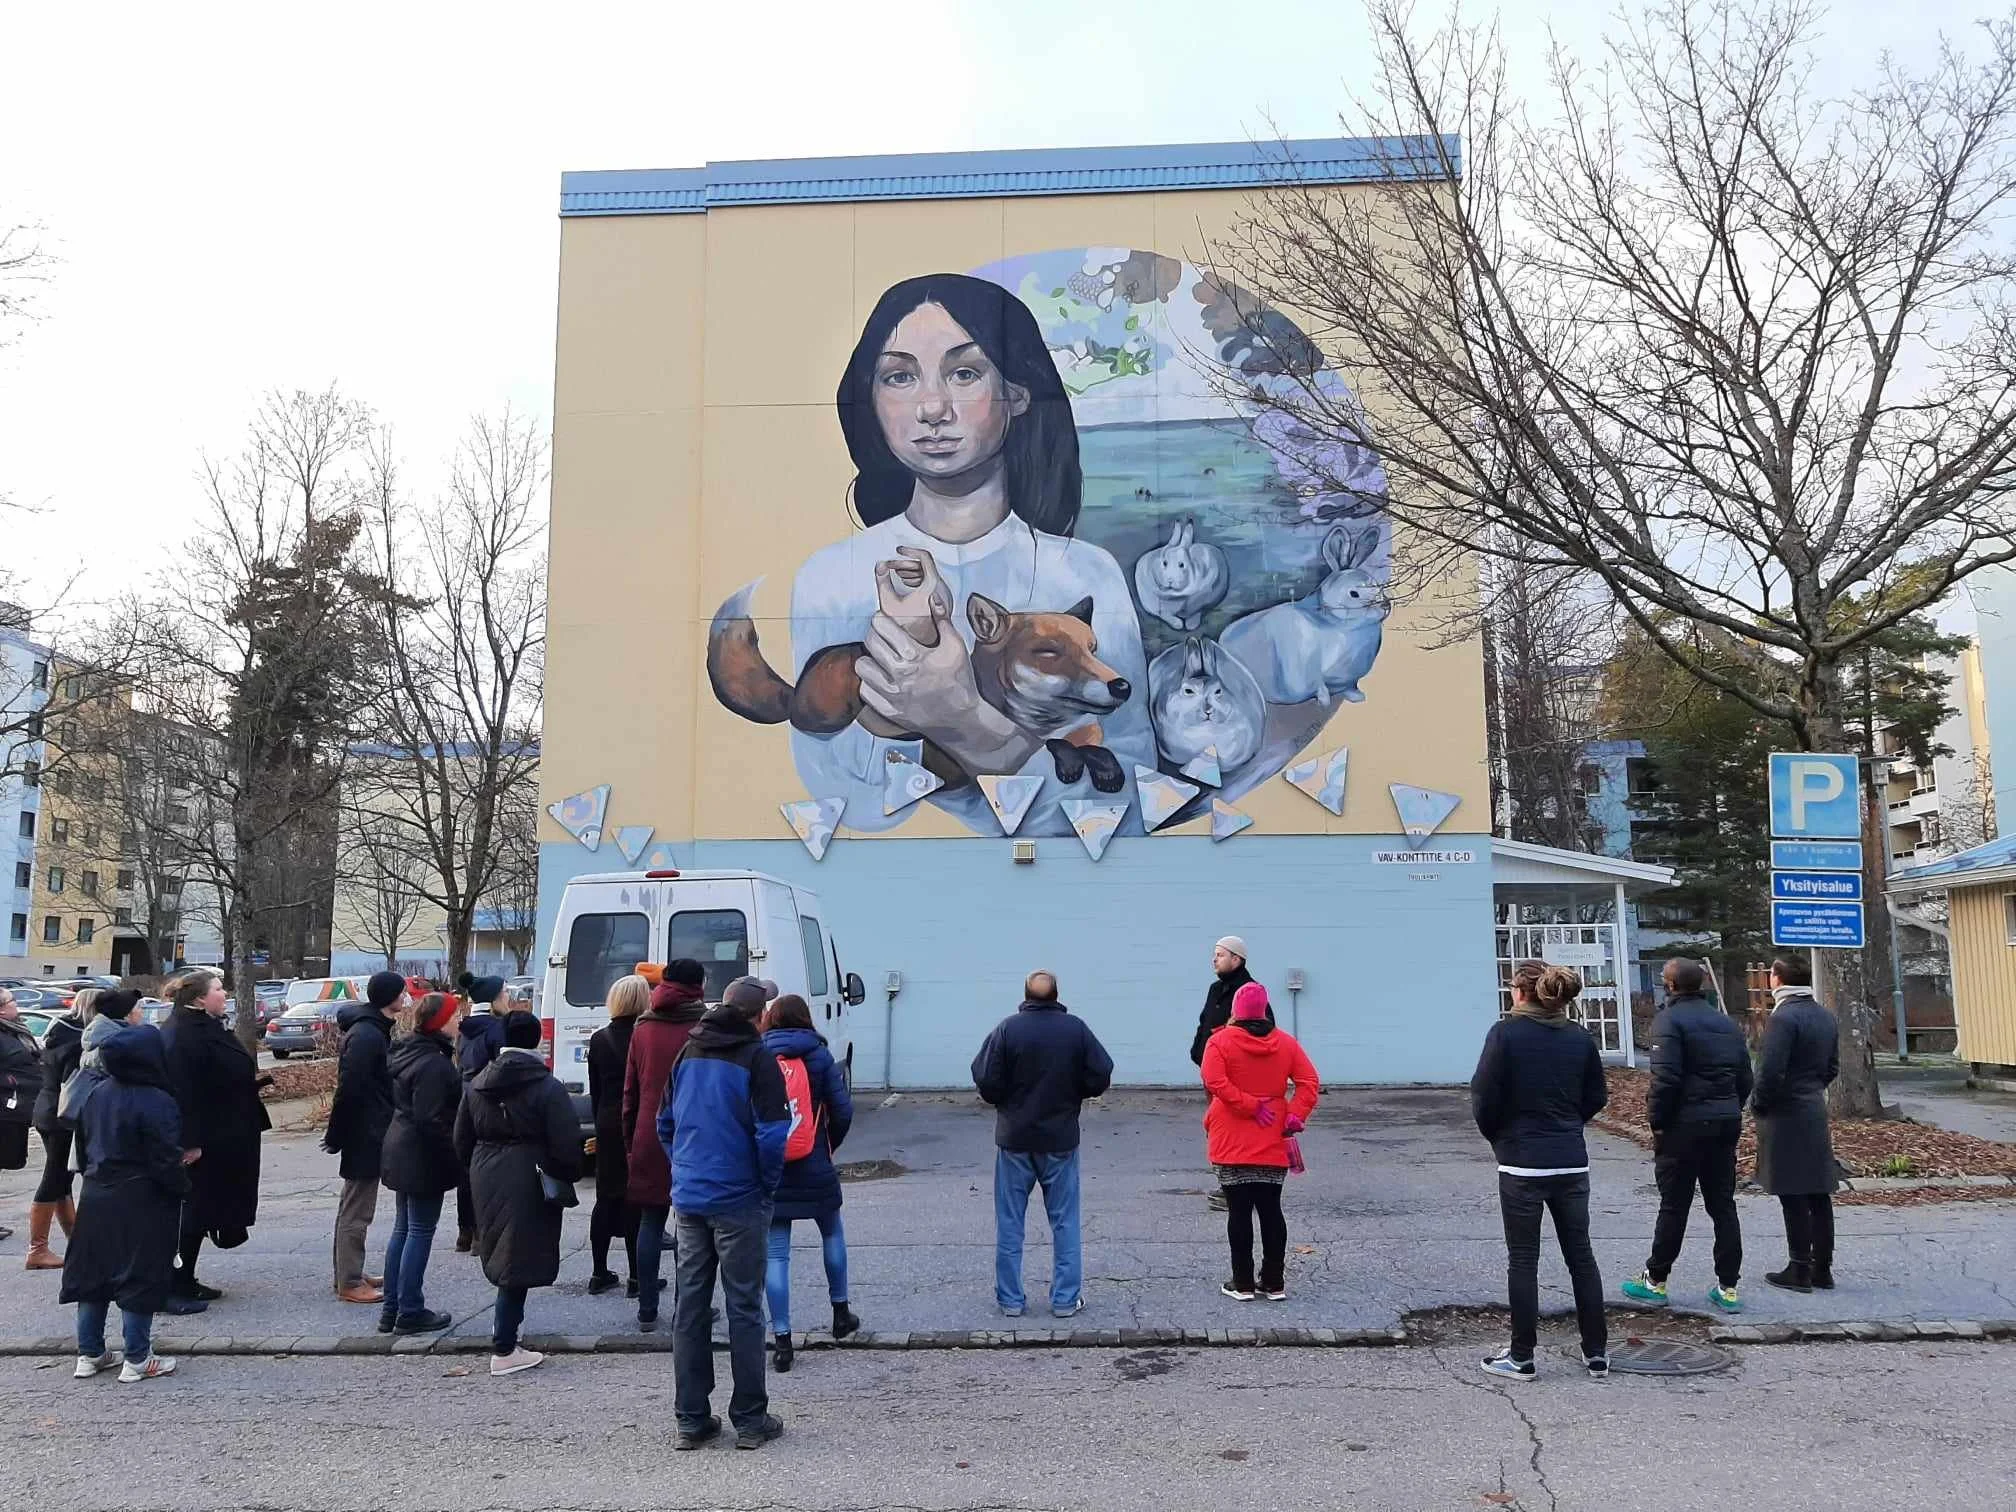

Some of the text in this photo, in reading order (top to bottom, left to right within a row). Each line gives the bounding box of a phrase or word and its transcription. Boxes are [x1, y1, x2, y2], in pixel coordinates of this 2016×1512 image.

[1790, 761, 1844, 830] P
[1377, 852, 1442, 862] VAV-KONTTITIE
[1781, 878, 1854, 895] Yksityisalue
